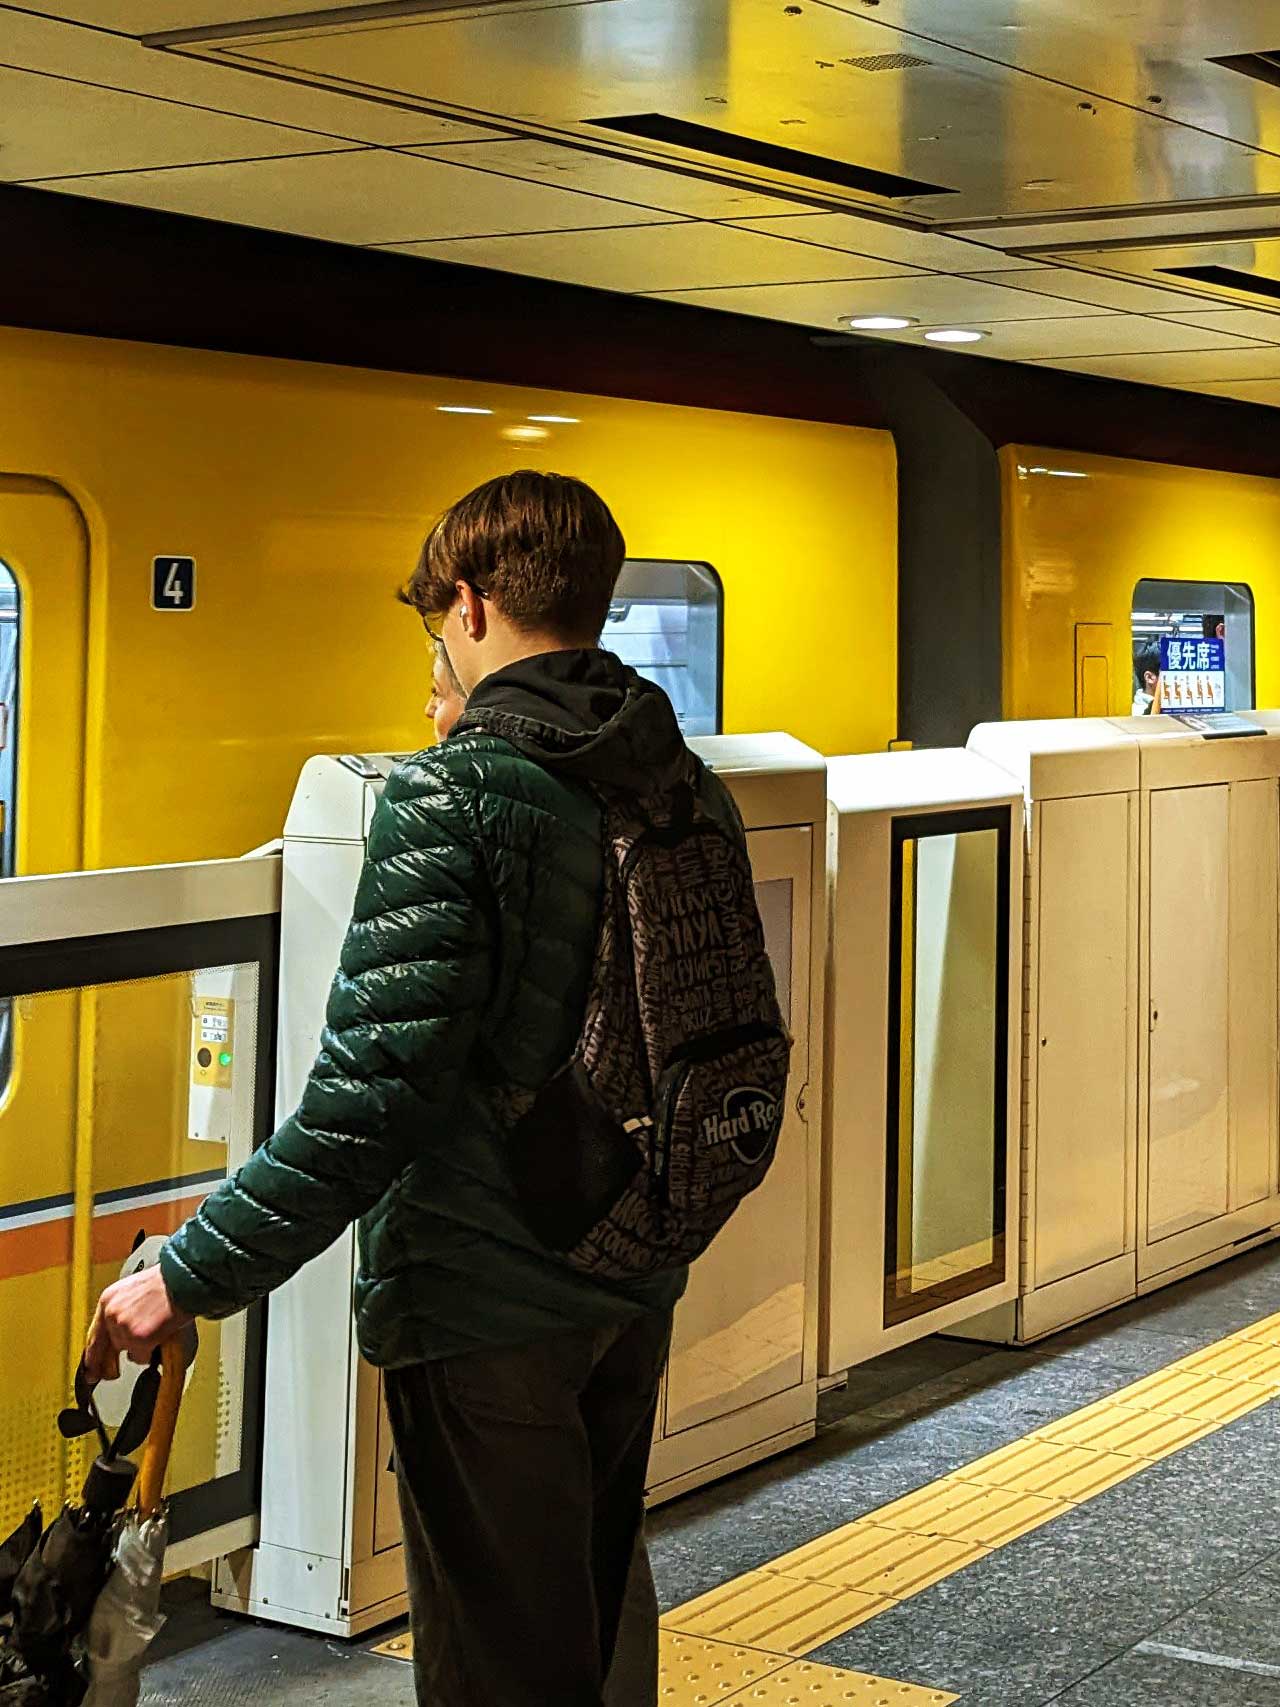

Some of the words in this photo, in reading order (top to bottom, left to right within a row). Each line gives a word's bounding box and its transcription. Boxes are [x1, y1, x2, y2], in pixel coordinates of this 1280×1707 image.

[163, 563, 184, 604] 4
[1167, 641, 1210, 670] 優先席
[702, 1106, 751, 1146] Hard
